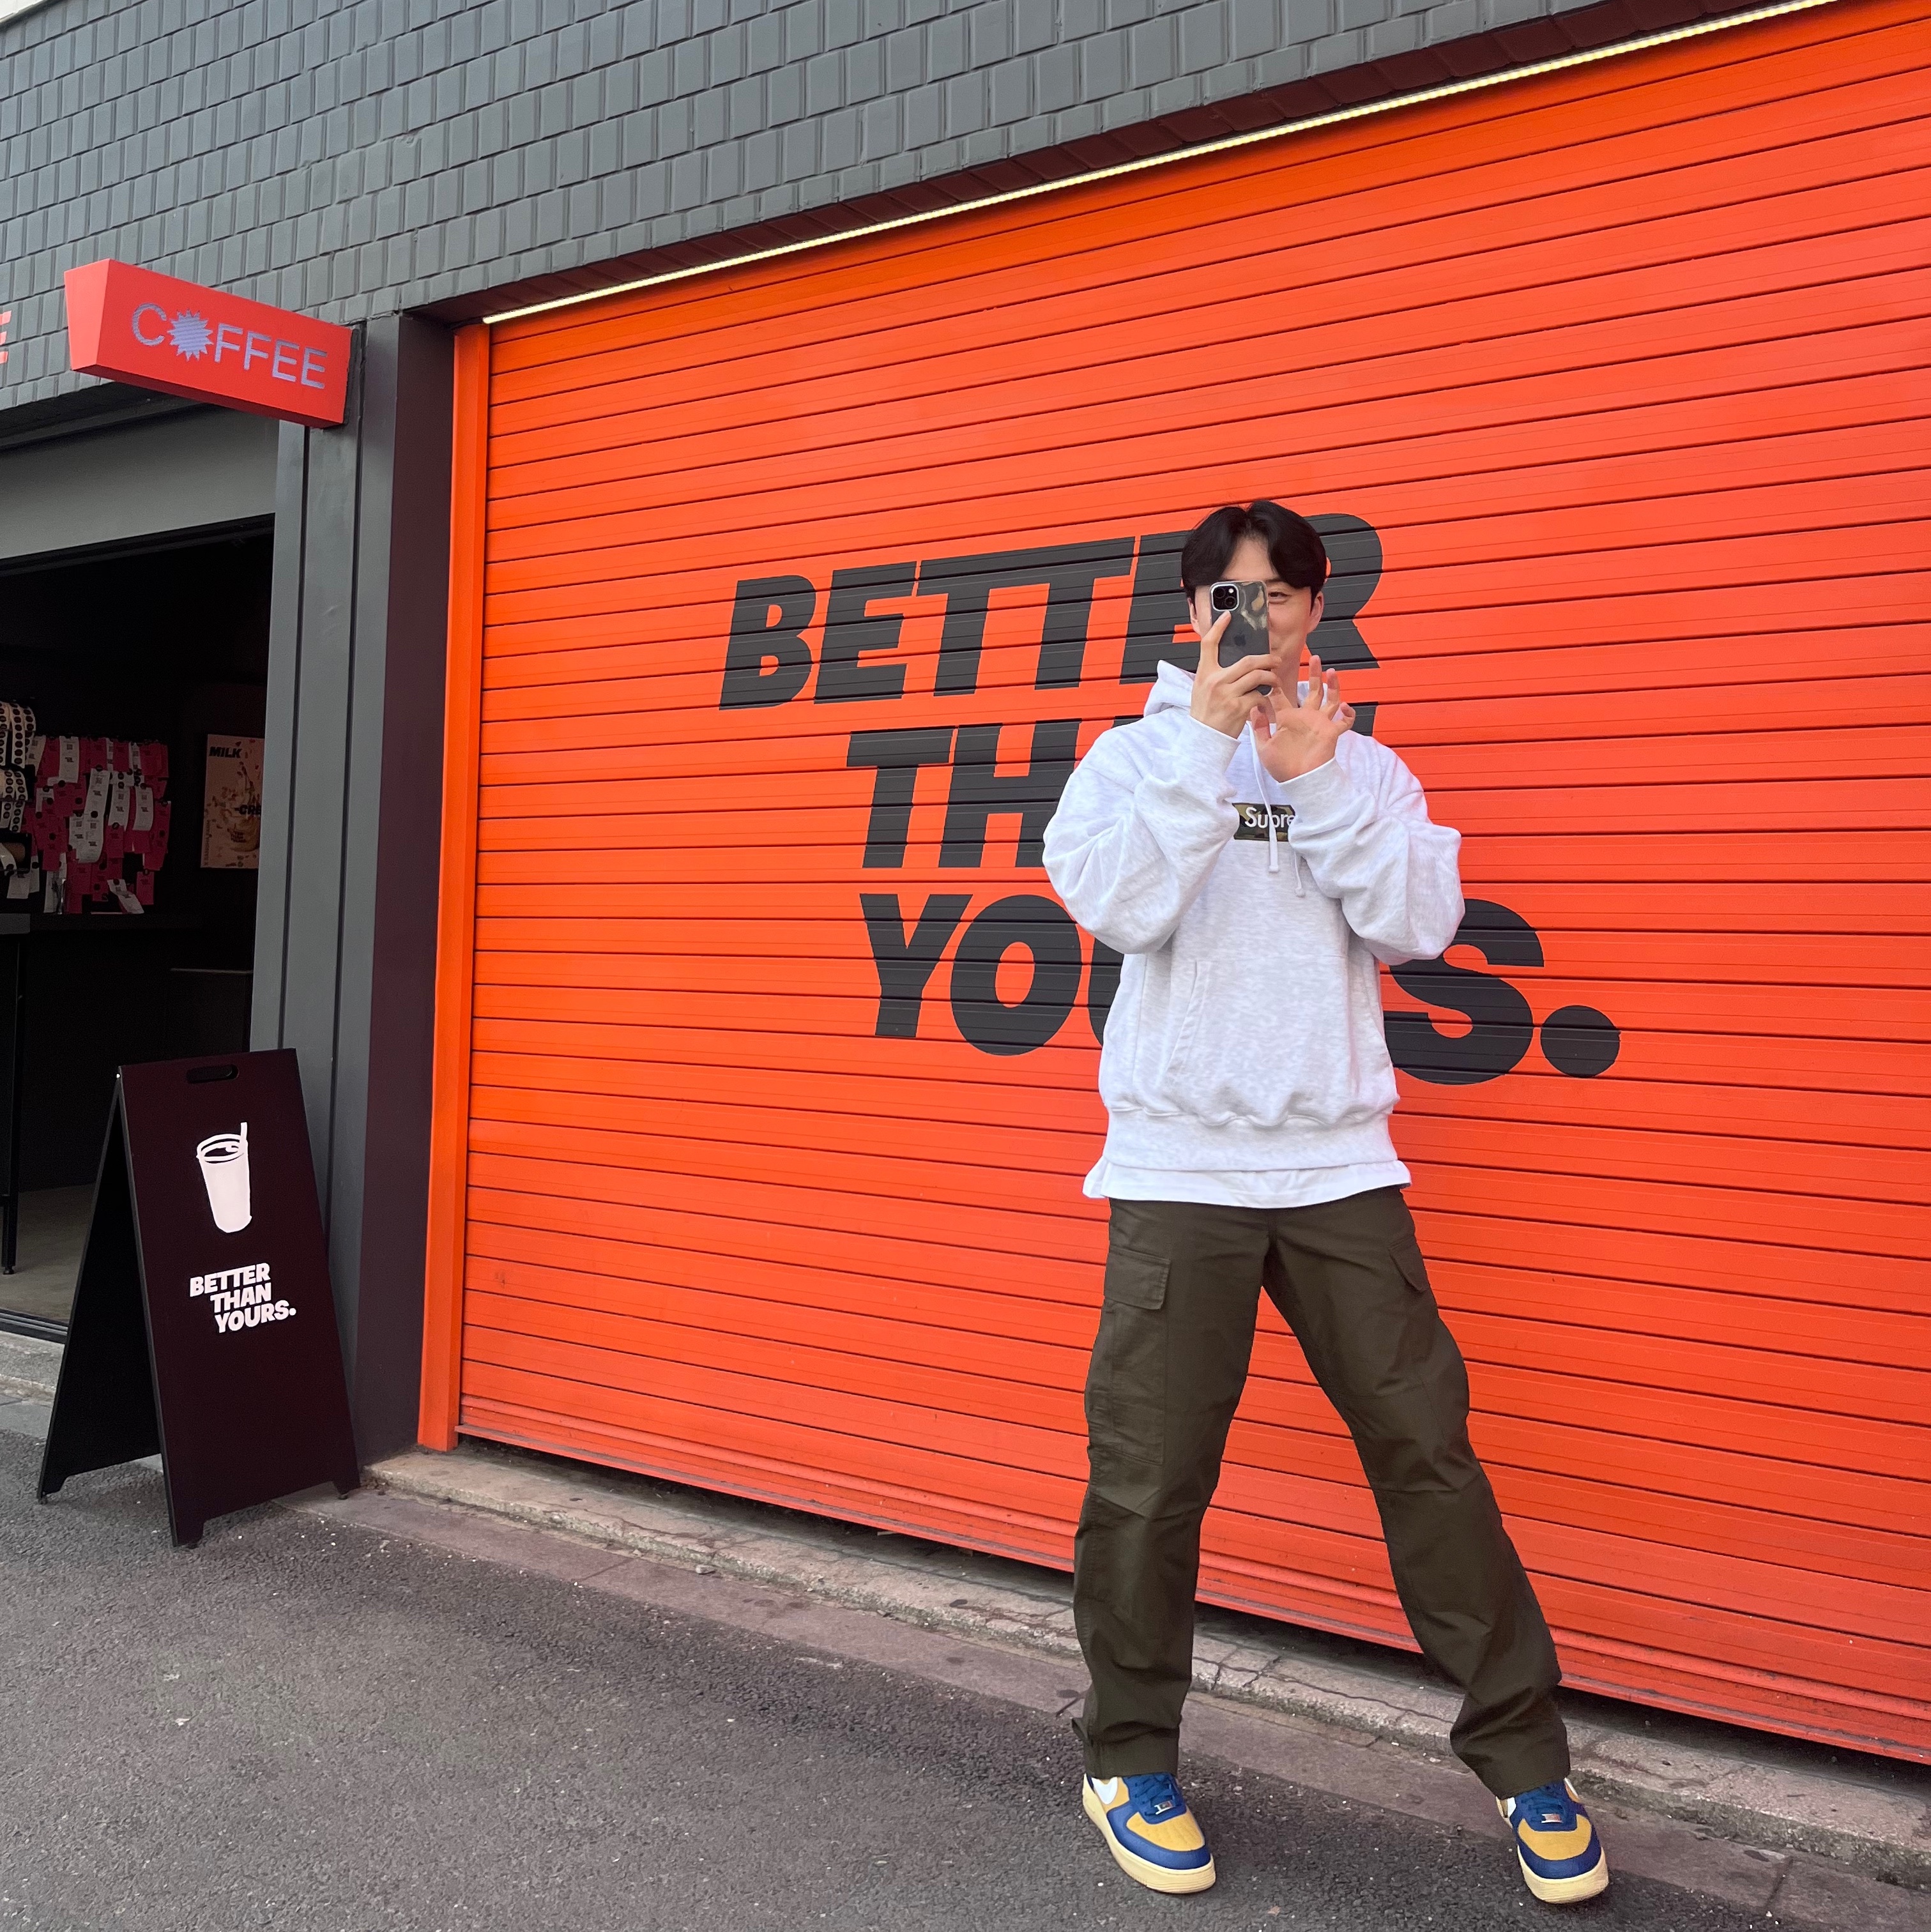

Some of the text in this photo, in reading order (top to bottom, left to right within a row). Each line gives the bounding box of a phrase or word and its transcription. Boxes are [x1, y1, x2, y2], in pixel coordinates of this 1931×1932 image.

[209, 746, 243, 759] MILK
[859, 894, 1621, 1086] YOS.
[190, 1262, 271, 1297] BETTER
[210, 1282, 272, 1313] THAN
[215, 1299, 297, 1334] YOURS.
